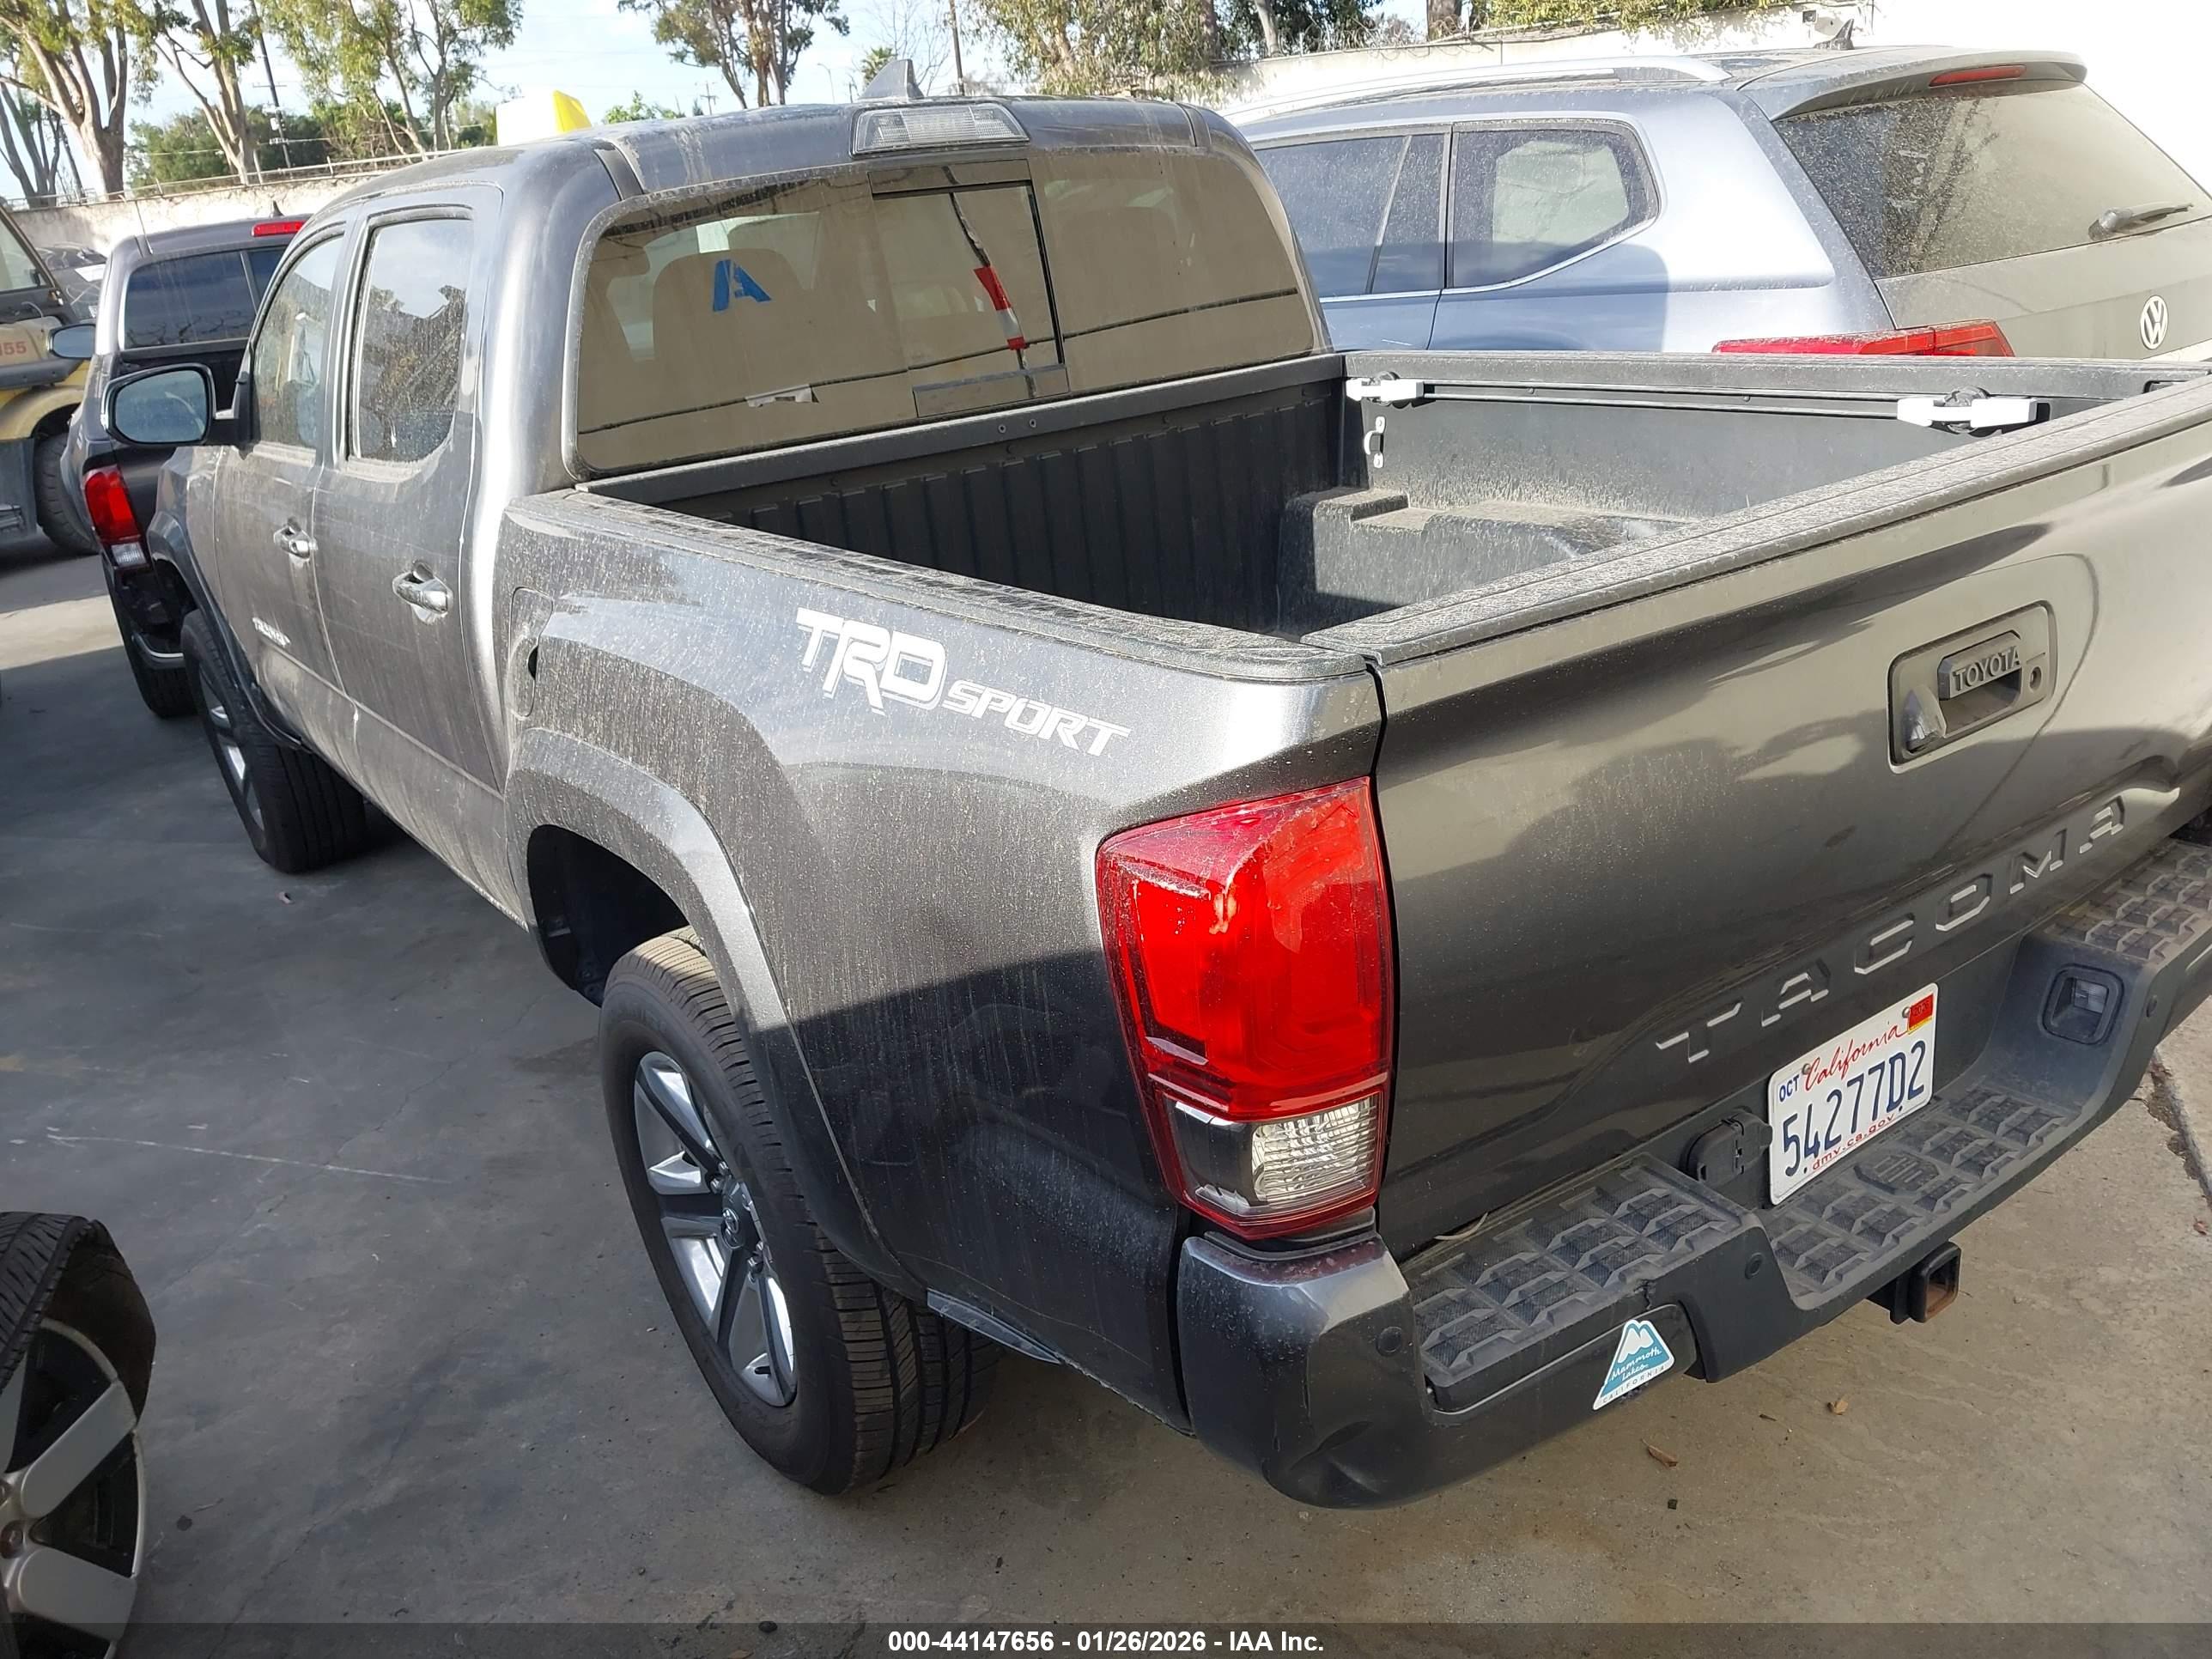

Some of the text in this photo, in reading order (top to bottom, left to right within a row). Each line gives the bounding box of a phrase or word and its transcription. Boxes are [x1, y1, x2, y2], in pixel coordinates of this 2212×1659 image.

[795, 606, 1133, 757] TRD SPORT
[1951, 645, 2021, 692] TOYOTA
[1655, 795, 2125, 1063] TACOMA
[1803, 1024, 1909, 1091] California
[1778, 1073, 1801, 1103] OCT
[1782, 1039, 1926, 1177] 54277D2
[1812, 1113, 1895, 1170] dmv.ca.gov
[1602, 1365, 1665, 1403] CALIFORNIA
[1609, 1346, 1662, 1381] Mammoth
[1621, 1363, 1649, 1382] Lakes
